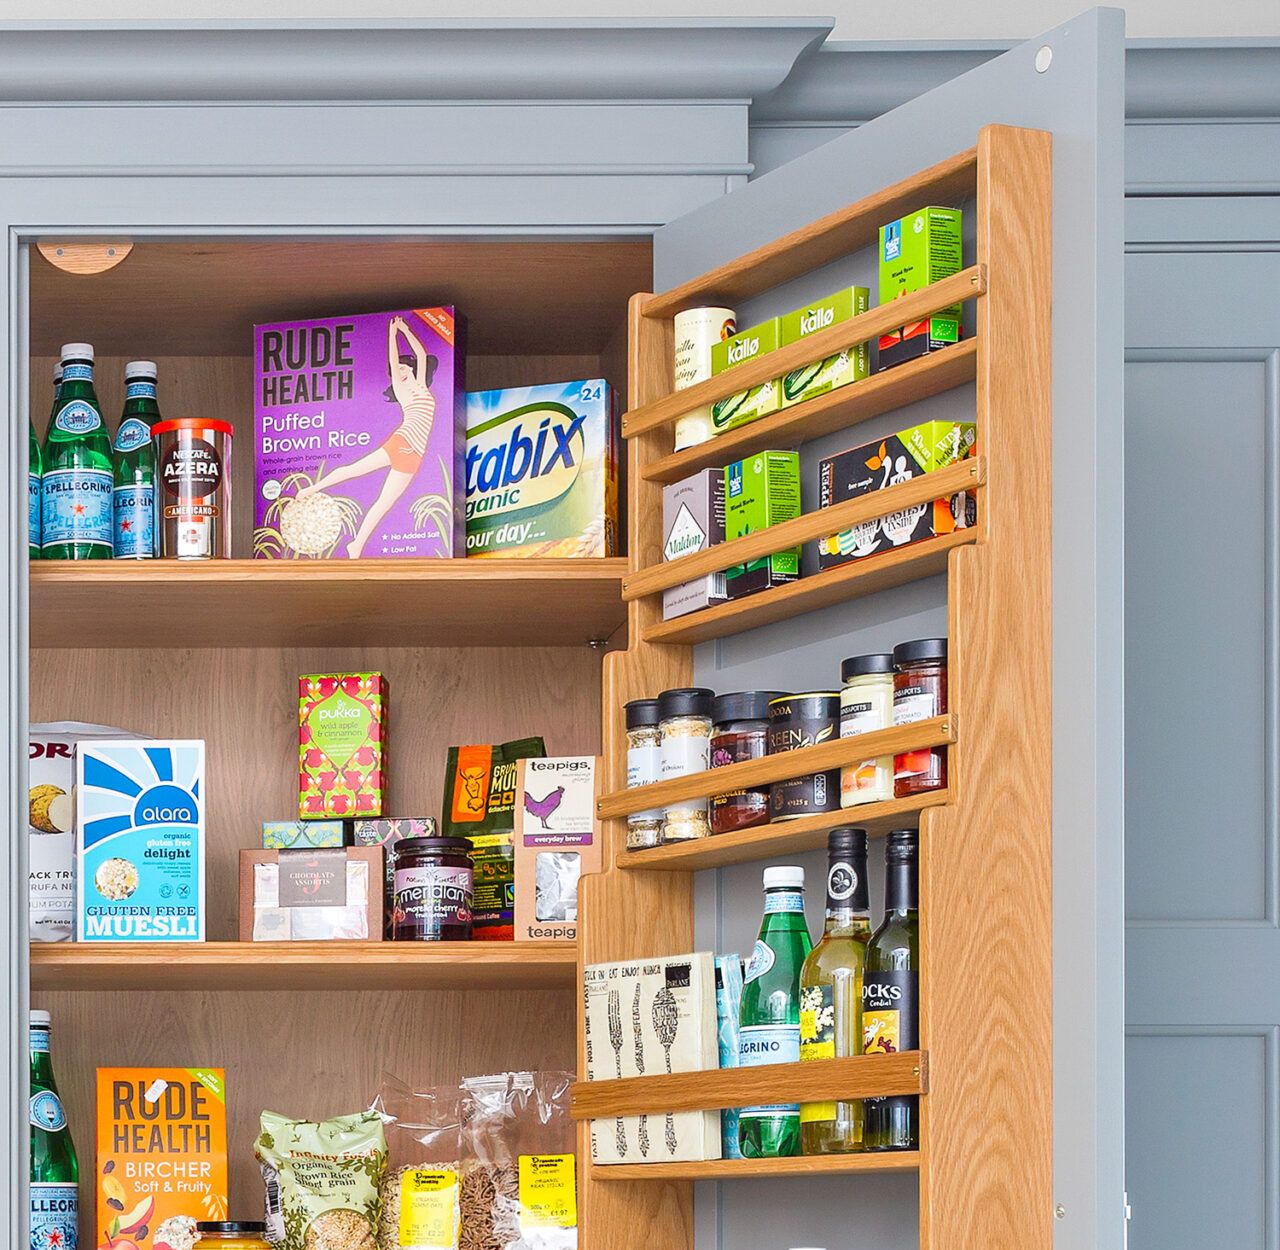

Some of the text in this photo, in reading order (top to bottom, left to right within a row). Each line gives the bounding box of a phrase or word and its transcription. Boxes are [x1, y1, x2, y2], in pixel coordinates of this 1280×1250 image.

[262, 325, 355, 373] RUDE
[262, 370, 354, 408] HEALTH
[582, 387, 601, 401] 24
[262, 411, 325, 433] Puffed
[262, 429, 371, 454] Brown Rice
[305, 451, 343, 463] brown rice
[164, 462, 219, 477] AZERA
[262, 464, 304, 476] and nothing
[44, 479, 112, 495] S.PELLEGRINO
[742, 497, 756, 508] Herbs
[886, 516, 915, 533] INSIDE
[391, 532, 426, 541] No Added
[669, 533, 702, 555] Maldon
[319, 708, 361, 721] pukka
[320, 722, 359, 730] wild apple
[324, 730, 363, 738] cinnamon
[530, 761, 591, 772] teapigs.
[142, 807, 191, 821] alara
[146, 838, 191, 848] gluten free
[163, 832, 191, 841] organic
[534, 835, 583, 844] everyday brew
[144, 848, 191, 860] delight
[289, 871, 335, 879] CHOCOLATS
[86, 906, 196, 916] GLUTEN FREE
[86, 916, 197, 937] MUESLI
[869, 999, 892, 1008] Cordial
[113, 1081, 210, 1121] RUDE
[113, 1124, 211, 1154] HEALTH
[288, 1149, 339, 1163] Infinity
[125, 1161, 212, 1178] BIRCHER
[291, 1162, 333, 1172] Organic
[293, 1170, 354, 1181] Brown Rice
[133, 1180, 212, 1196] Soft & Fruity
[295, 1176, 357, 1189] Short grain
